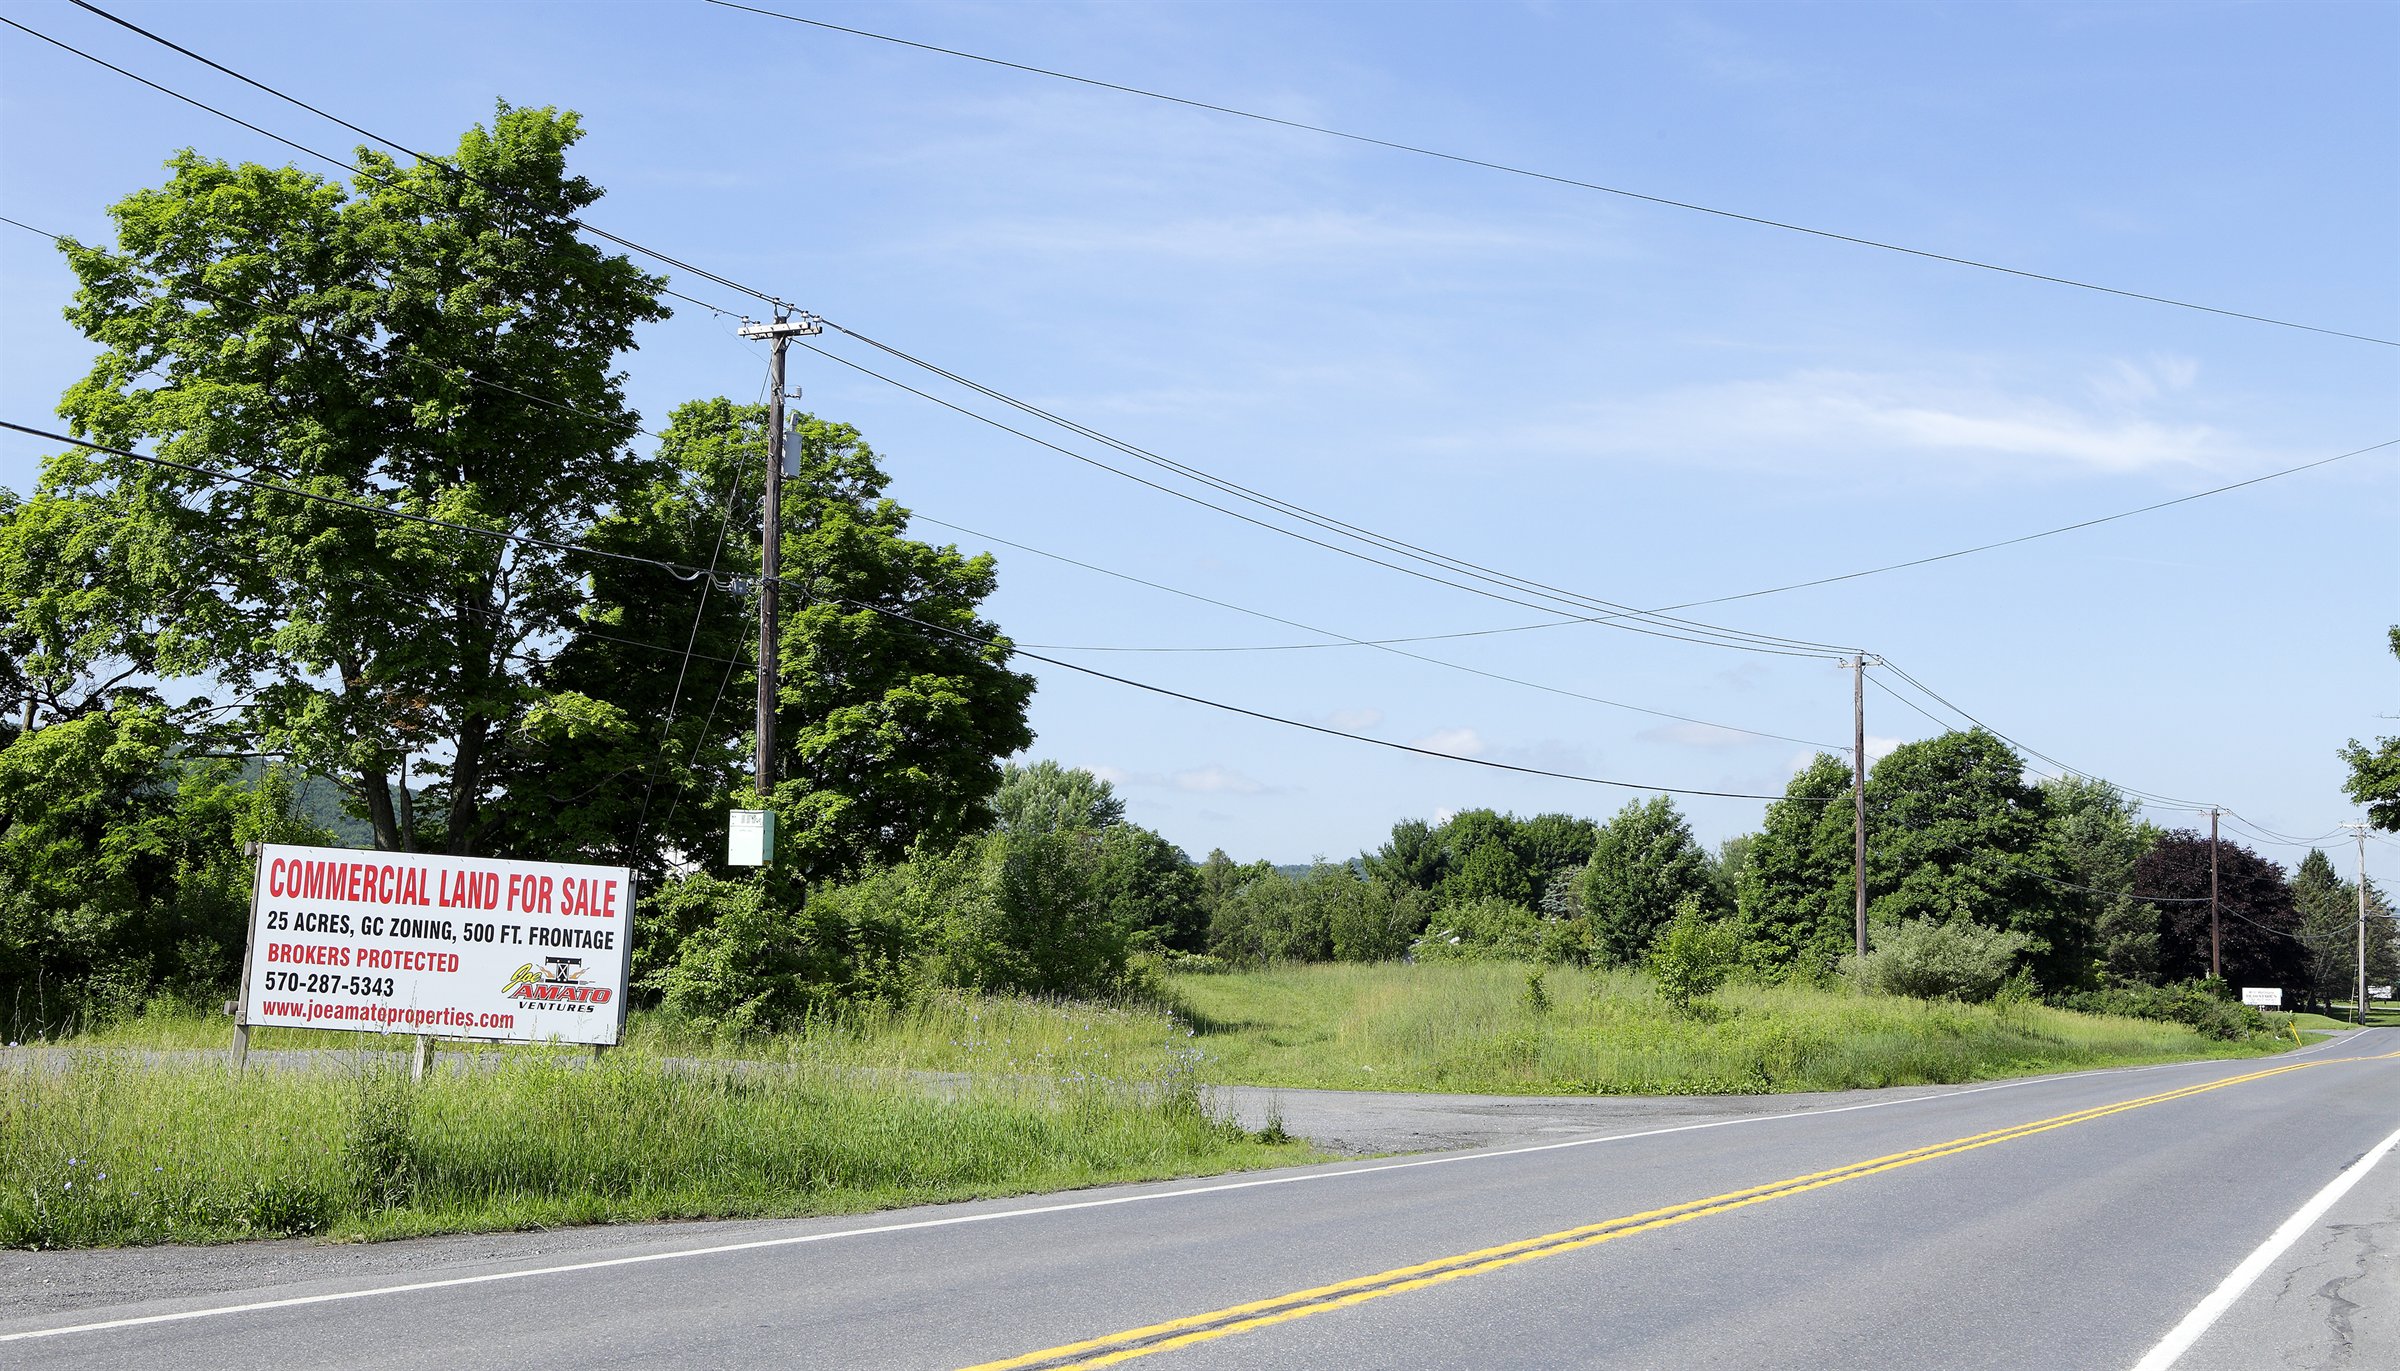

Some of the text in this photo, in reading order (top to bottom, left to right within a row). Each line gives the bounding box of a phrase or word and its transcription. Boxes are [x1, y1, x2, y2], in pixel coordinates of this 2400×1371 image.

[269, 857, 617, 918] COMMERCIAL LAND FOR SALE
[267, 910, 614, 950] 25 ACRES, GC ZONING, 500 FT. FRONTAGE
[267, 943, 460, 972] BROKERS PROTECTED
[265, 971, 394, 997] 570-287-5343
[501, 963, 542, 993] Joe
[507, 983, 612, 1004] AMATO
[519, 1001, 595, 1013] VENTURES
[262, 998, 514, 1029] www.joeamatoproperties.com
